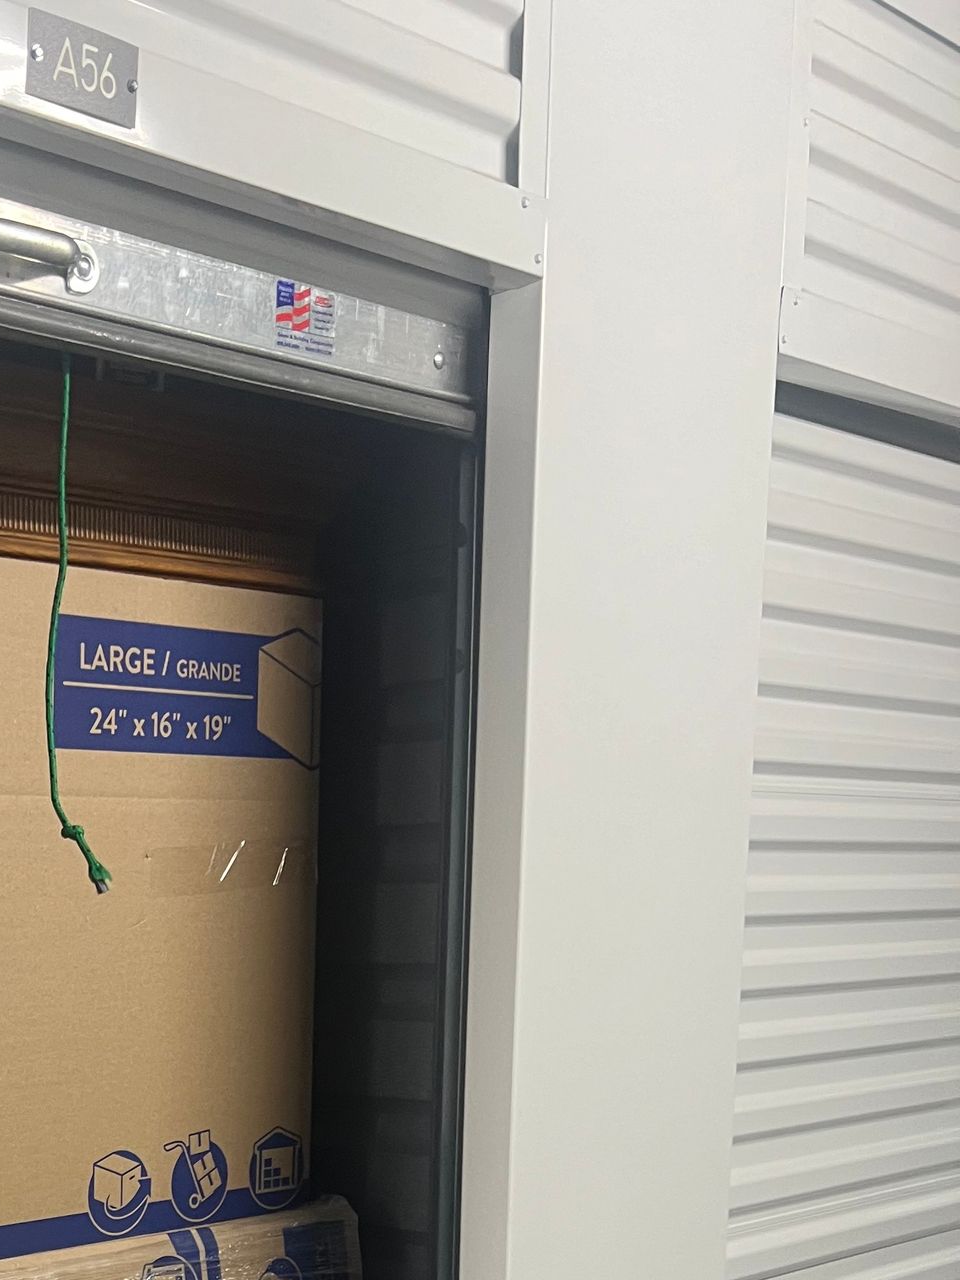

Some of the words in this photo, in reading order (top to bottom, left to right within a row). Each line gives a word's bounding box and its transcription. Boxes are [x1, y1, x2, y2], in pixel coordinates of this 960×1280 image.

[52, 37, 117, 100] A56
[79, 642, 155, 676] LARGE
[161, 651, 171, 676] /
[176, 658, 241, 683] GRANDE
[89, 707, 128, 736] 24"
[132, 719, 146, 737] x
[151, 711, 181, 739] 16"
[185, 721, 198, 740] x
[203, 714, 232, 741] 19"
